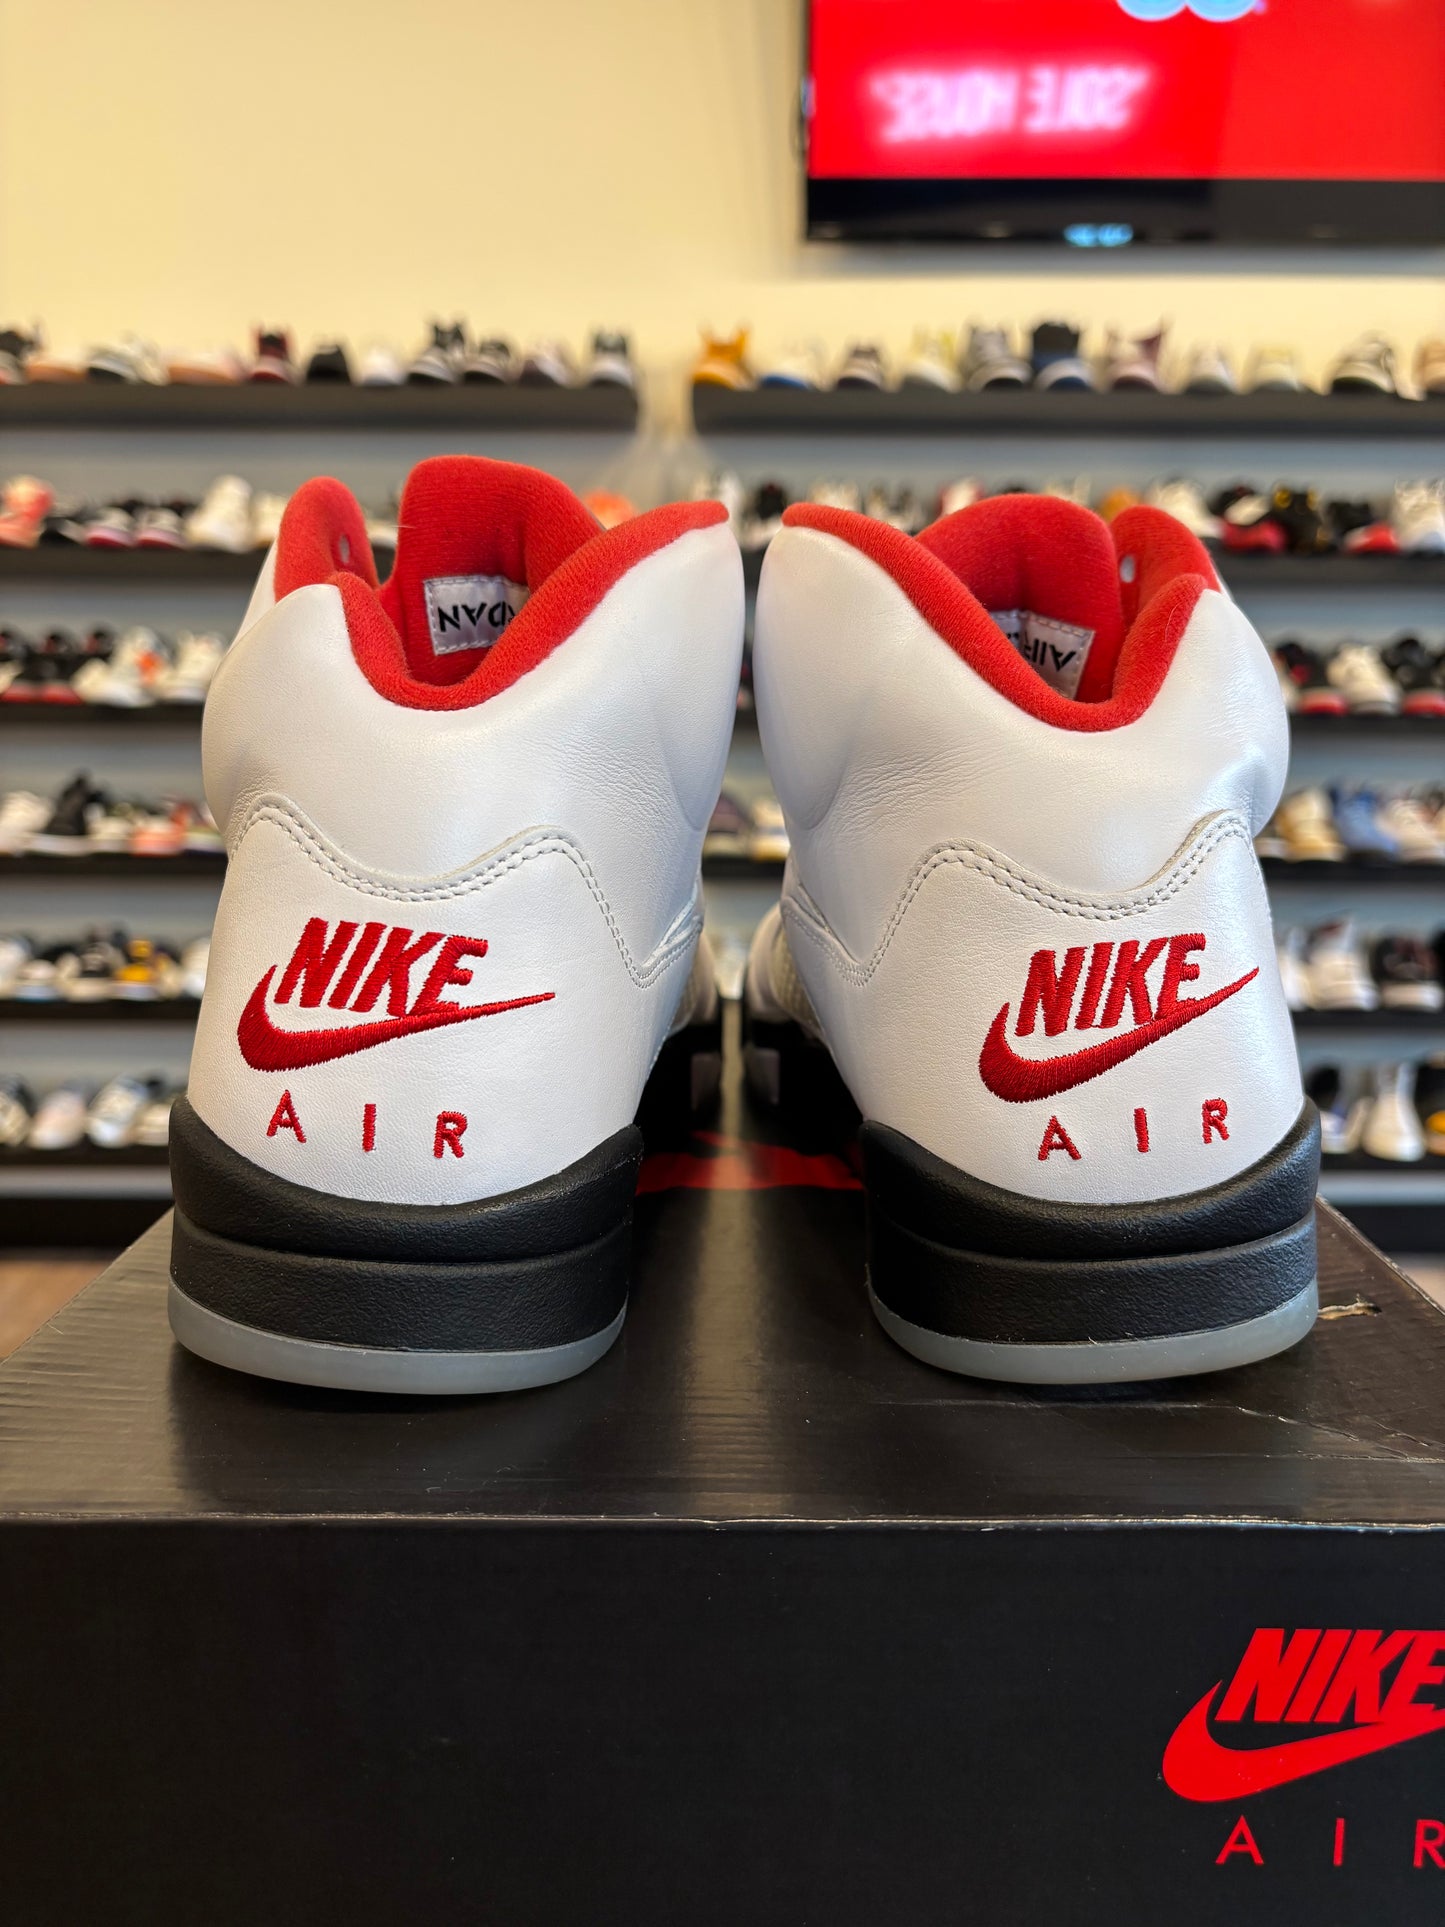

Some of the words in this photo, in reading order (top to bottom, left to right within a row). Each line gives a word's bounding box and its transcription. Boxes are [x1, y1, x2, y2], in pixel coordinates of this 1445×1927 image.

[274, 917, 488, 1017] NIKE
[1014, 933, 1206, 1036] NIKE
[266, 1089, 468, 1158] AIR
[1037, 1098, 1230, 1161] AIR
[1214, 1628, 1445, 1723] NIKE
[1215, 1814, 1445, 1869] AIR
